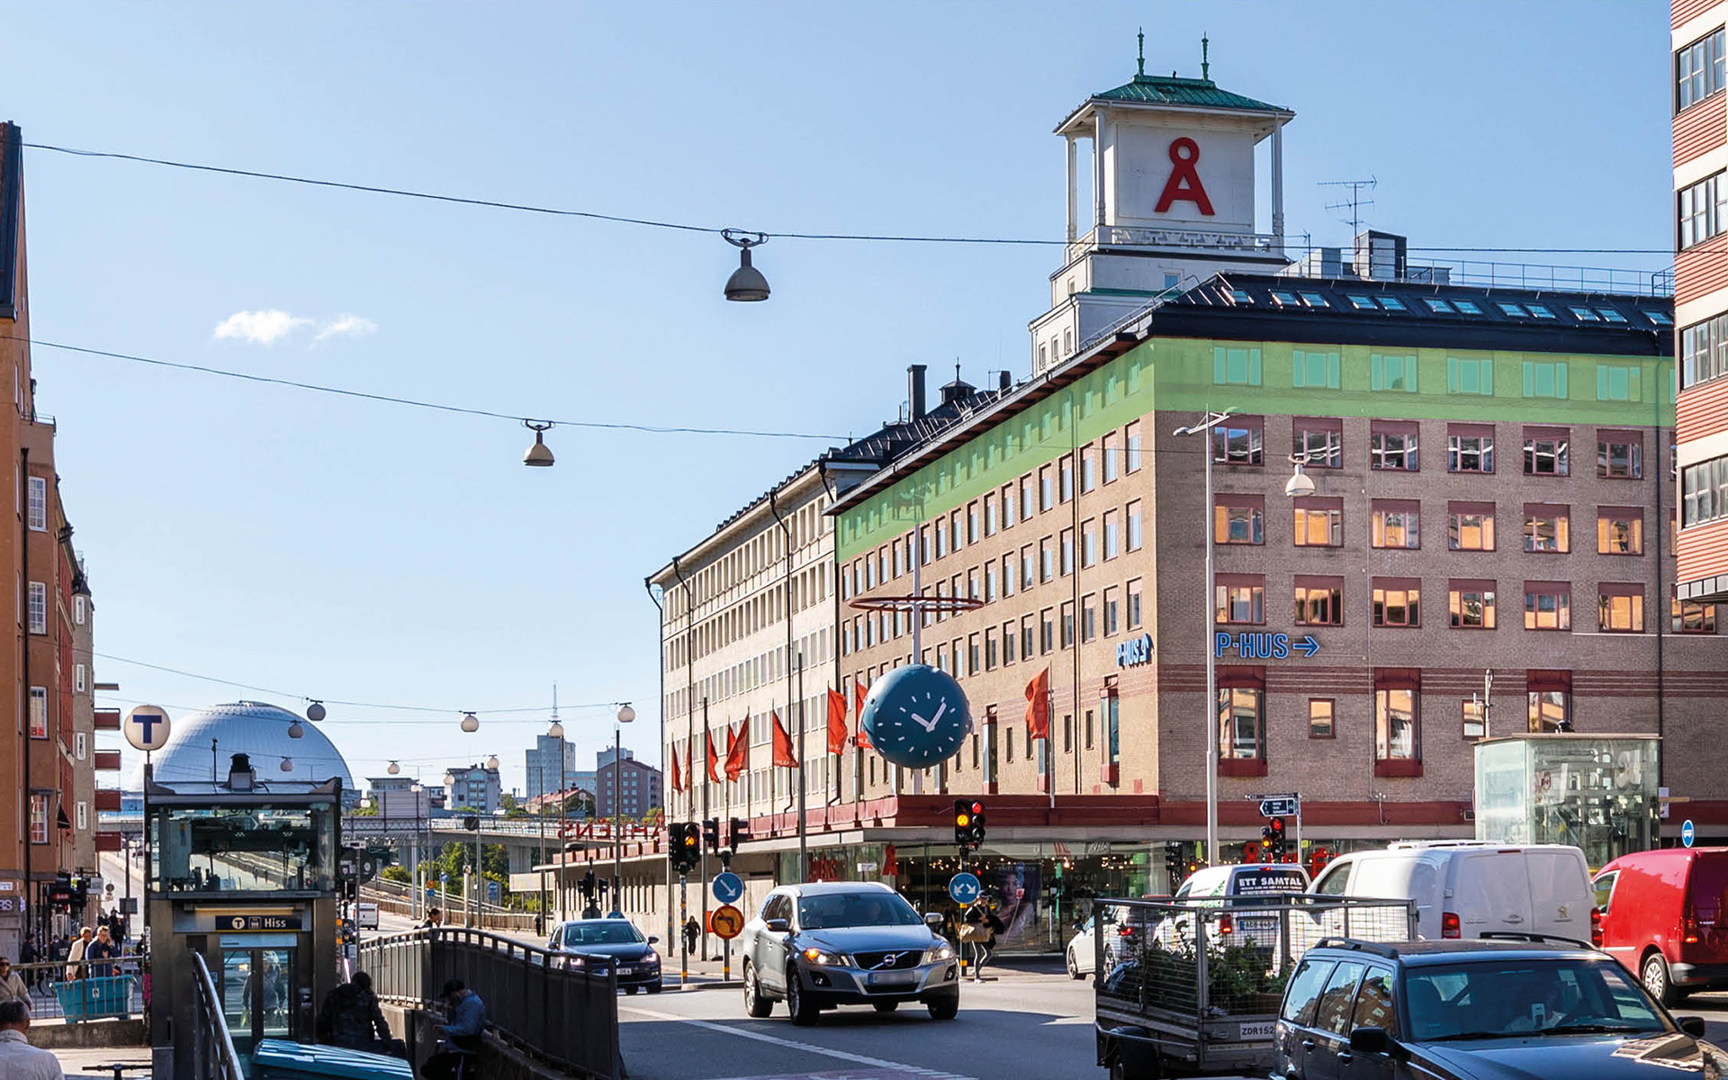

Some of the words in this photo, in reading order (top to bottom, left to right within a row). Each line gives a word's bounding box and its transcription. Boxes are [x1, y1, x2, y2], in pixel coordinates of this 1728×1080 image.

[1154, 137, 1215, 216] Å
[133, 715, 162, 744] T
[1239, 878, 1257, 887] ETT
[1261, 877, 1302, 886] SAMTAL
[264, 917, 287, 928] Hiss
